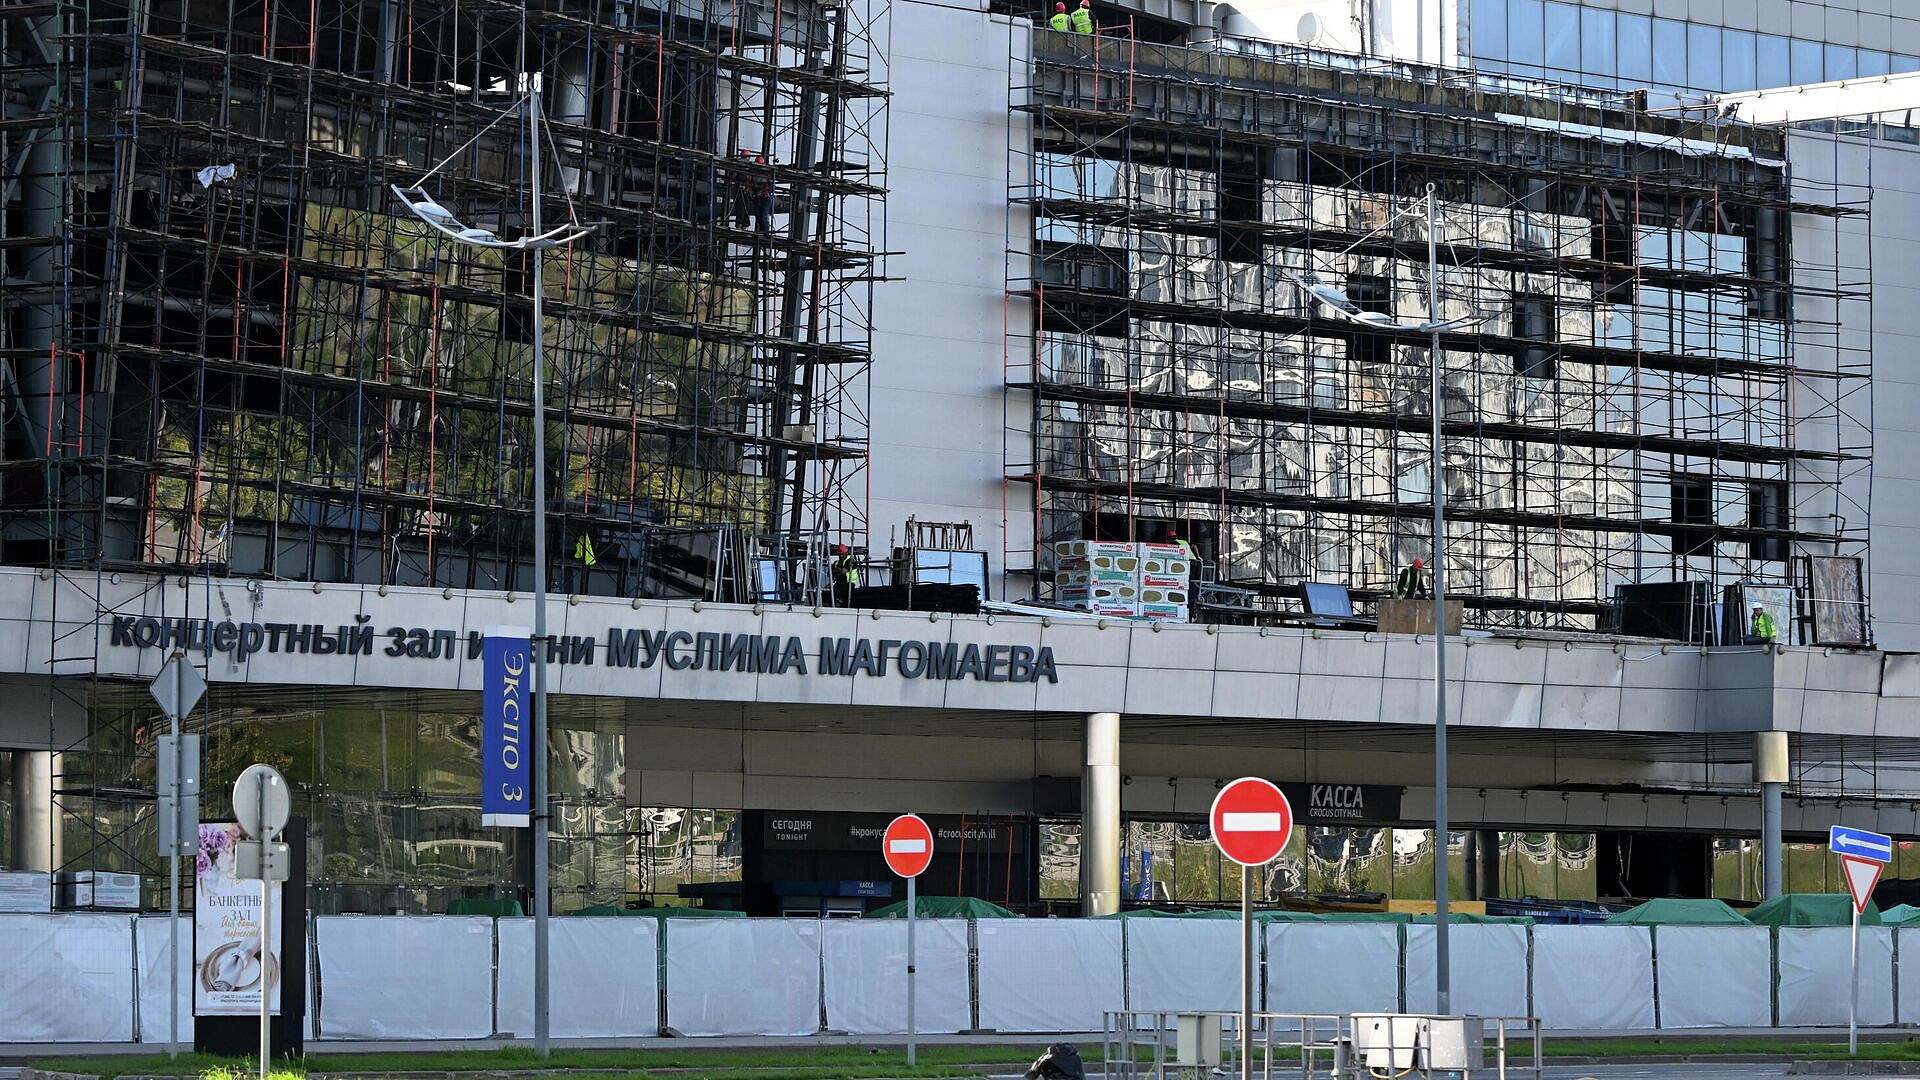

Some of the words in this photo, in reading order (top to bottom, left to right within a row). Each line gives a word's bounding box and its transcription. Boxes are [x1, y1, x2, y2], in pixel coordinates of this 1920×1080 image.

[110, 613, 374, 663] концертный
[385, 627, 456, 659] зал
[468, 630, 595, 665] ини
[607, 627, 808, 676] МУСЛИМА
[819, 637, 1059, 685] МАГОМАЕВА
[502, 782, 524, 802] 3
[1310, 784, 1364, 808] КАССА
[1309, 807, 1334, 818] CROCUS
[1334, 808, 1347, 818] CITY
[1347, 808, 1364, 818] HALL
[772, 819, 812, 831] СЕГОДНЯ
[776, 833, 808, 841] TONIGHT
[230, 910, 251, 921] ЗАЛ
